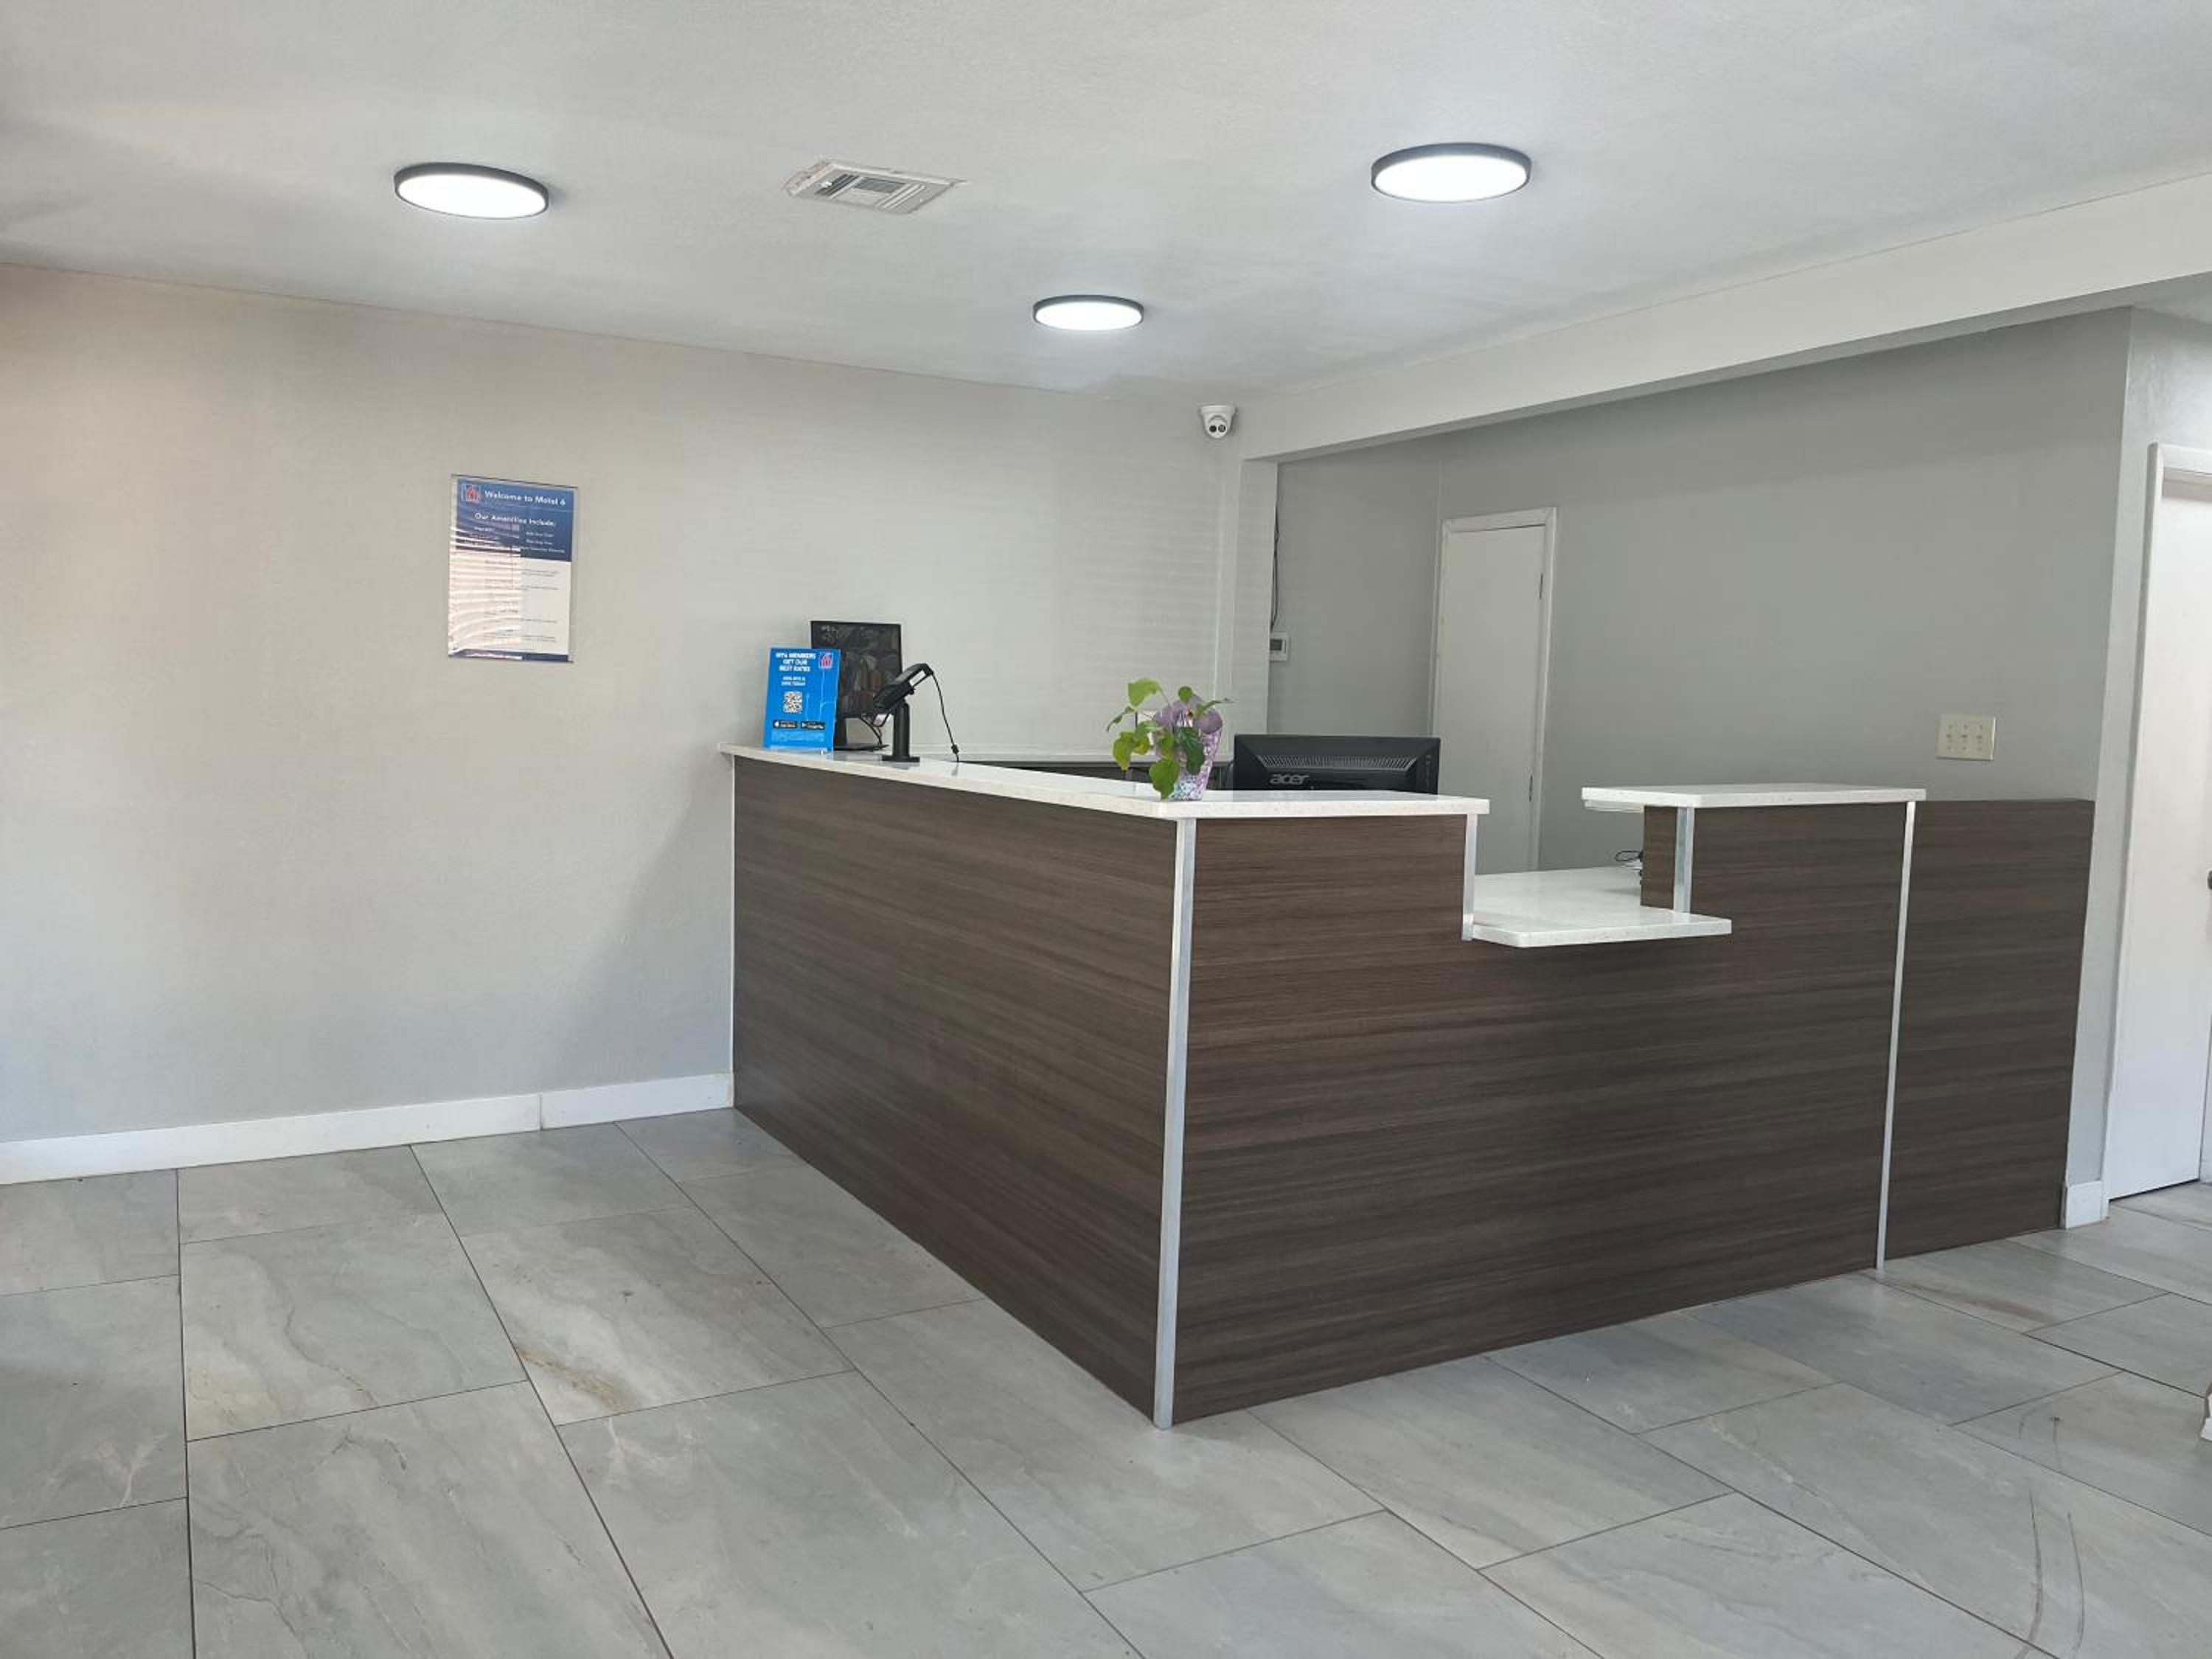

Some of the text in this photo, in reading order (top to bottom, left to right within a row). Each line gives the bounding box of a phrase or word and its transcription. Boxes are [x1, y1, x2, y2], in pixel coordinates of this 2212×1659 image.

[484, 490, 566, 506] Welcome to Motel 6
[491, 515, 526, 524] Amenities
[1269, 773, 1310, 785] acer
